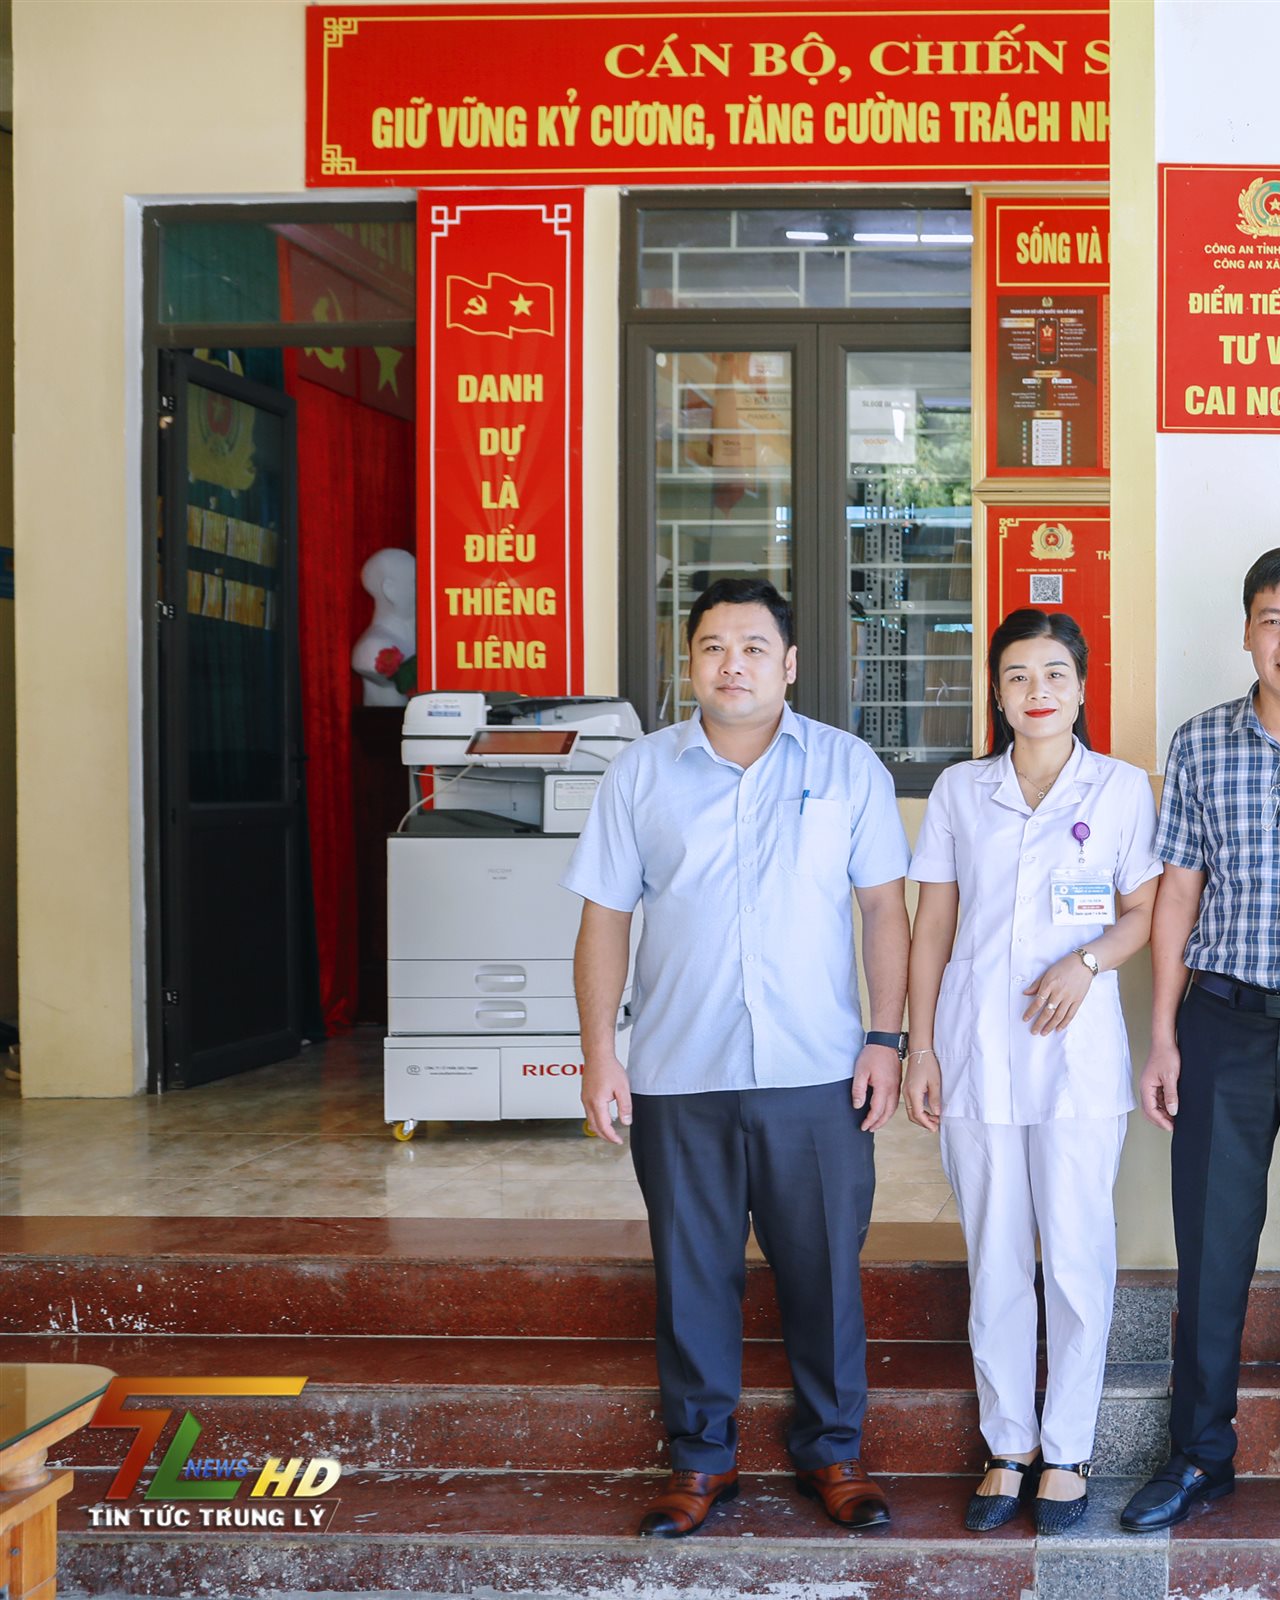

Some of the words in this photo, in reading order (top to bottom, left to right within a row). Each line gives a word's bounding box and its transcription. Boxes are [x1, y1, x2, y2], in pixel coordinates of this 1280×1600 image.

[604, 33, 733, 79] CÁN
[749, 31, 852, 86] BỘ,
[869, 24, 1068, 76] CHIẾN
[371, 96, 433, 149] GIỮ
[437, 96, 527, 148] VỮNG
[537, 87, 581, 147] KỶ
[590, 100, 715, 151] CƯƠNG,
[724, 94, 814, 145] TĂNG
[824, 91, 941, 145] CƯỜNG
[949, 92, 1060, 143] TRÁCH
[1016, 221, 1071, 265] SỐNG
[1076, 225, 1103, 264] VÀ
[1204, 242, 1236, 255] CÔNG
[1238, 245, 1254, 255] AN
[1213, 257, 1245, 269] CÔNG
[1247, 260, 1263, 269] AN
[1265, 258, 1280, 269] XÃ
[1188, 284, 1244, 315] ĐIỂM
[1218, 332, 1261, 365] TƯ
[457, 373, 544, 403] DANH
[1184, 385, 1236, 416] CAI
[479, 424, 526, 462] DỰ
[481, 474, 520, 509] LÀ
[463, 523, 536, 563] ĐIỀU
[444, 579, 556, 616] THIÊNG
[456, 634, 546, 670] LIÊNG
